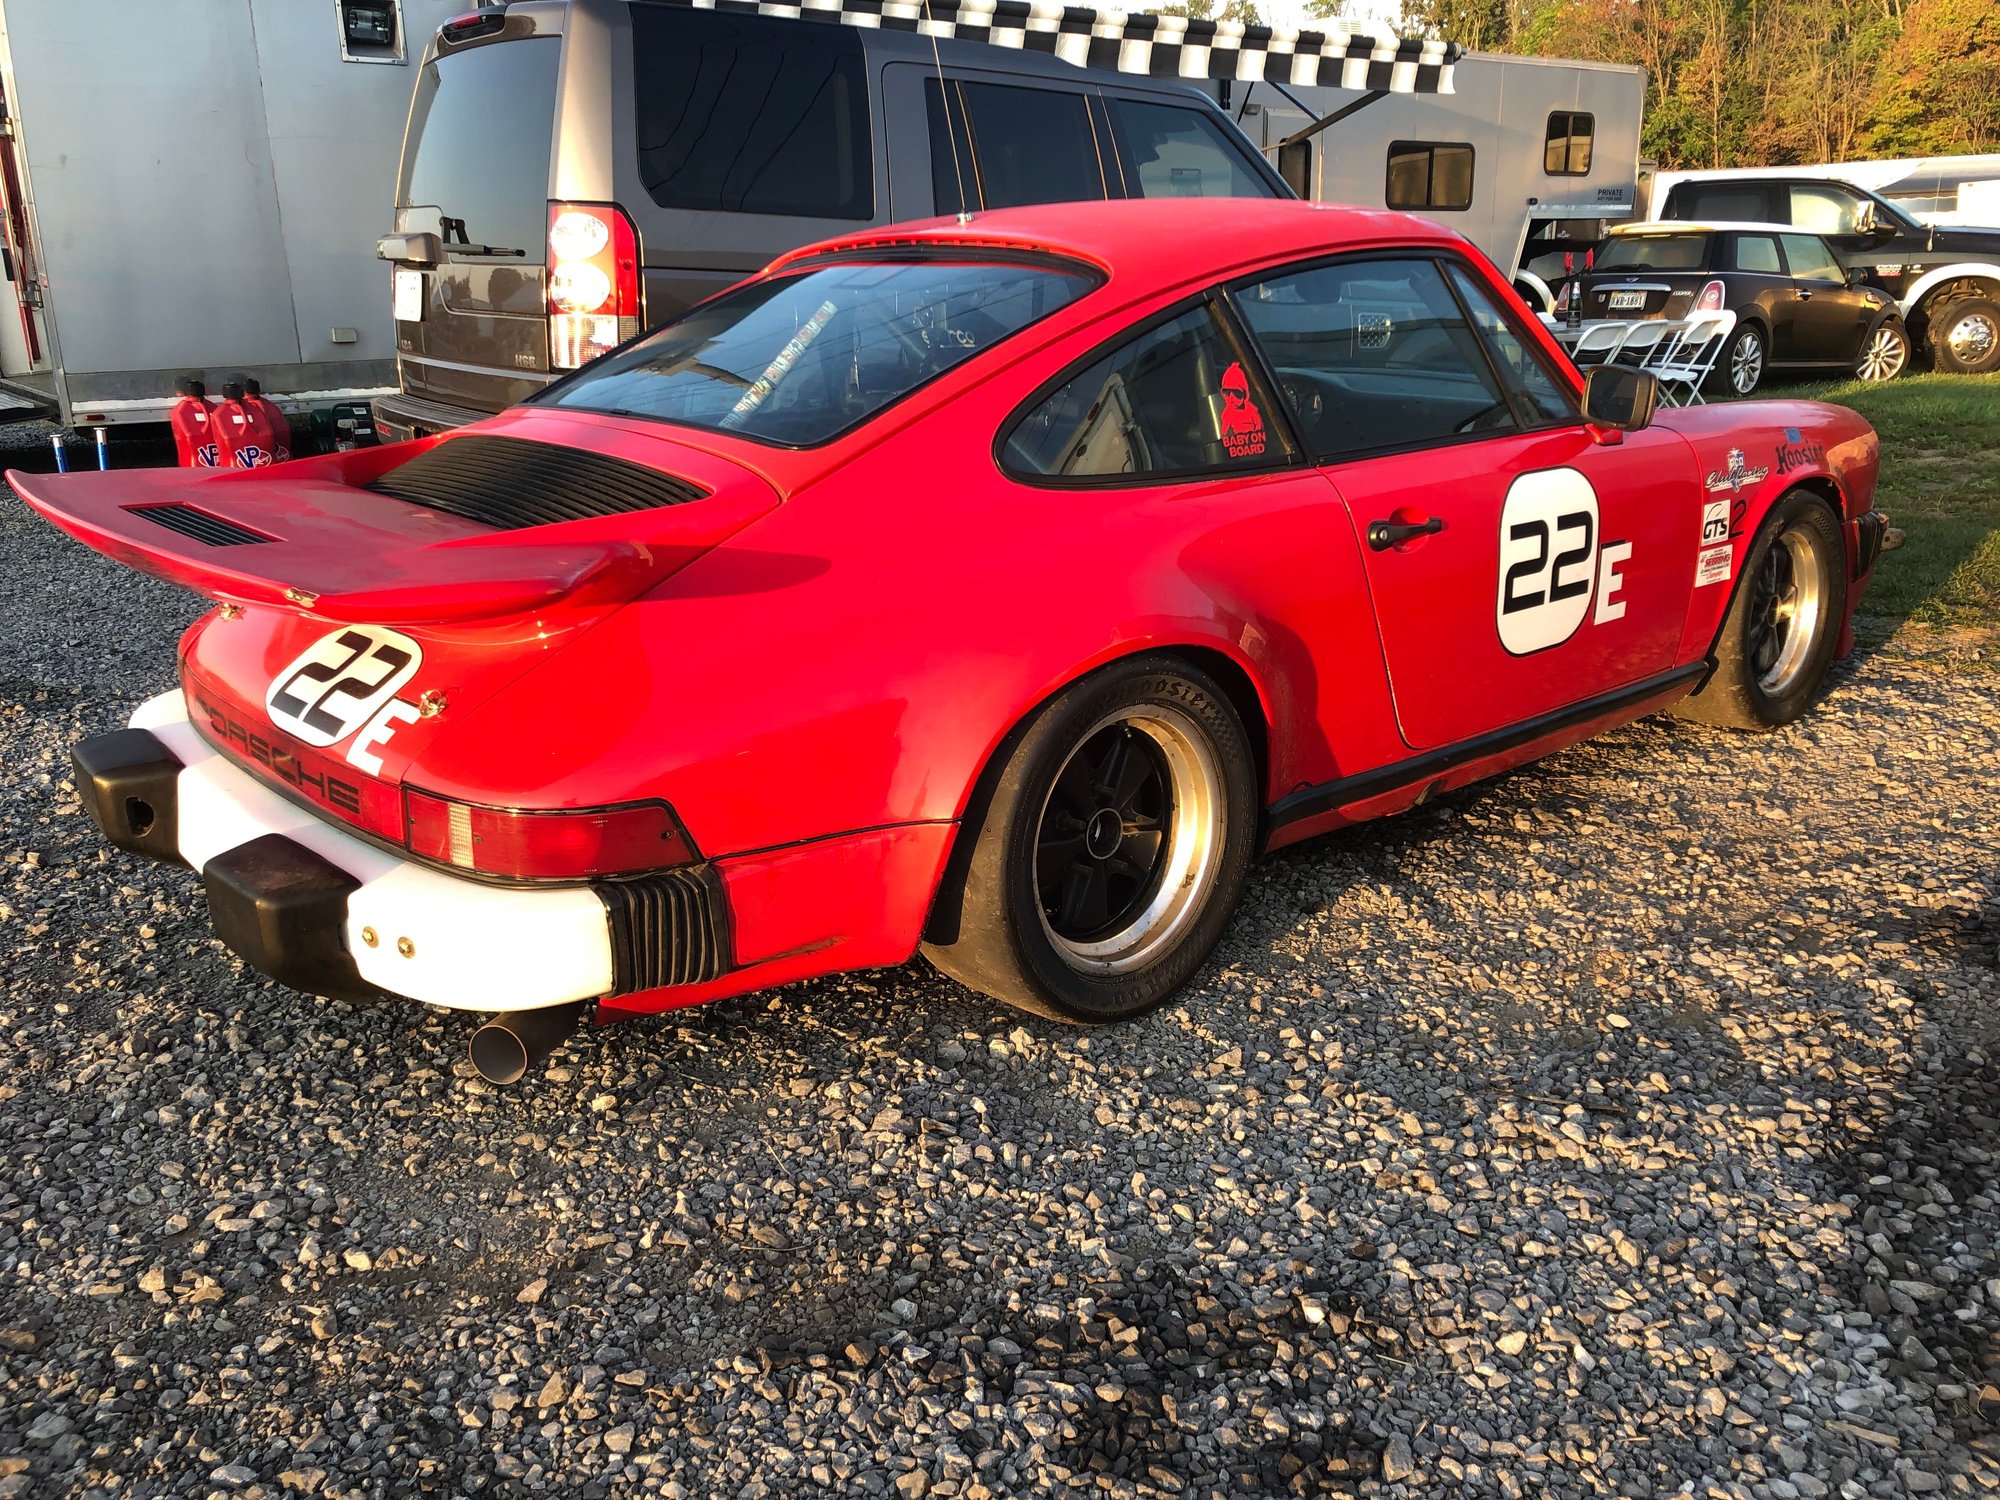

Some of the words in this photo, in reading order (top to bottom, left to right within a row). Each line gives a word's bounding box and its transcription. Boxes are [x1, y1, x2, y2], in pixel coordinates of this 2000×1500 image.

[235, 446, 260, 468] VP
[1222, 434, 1249, 447] BABY
[1250, 432, 1267, 443] ON
[1228, 444, 1265, 457] BOARD
[1775, 439, 1824, 475] Hoosier
[1703, 517, 1728, 540] GTS
[1728, 499, 1747, 539] 2
[1502, 510, 1594, 616] 22
[1594, 538, 1633, 626] E
[269, 630, 413, 738] 22
[345, 696, 422, 777] E
